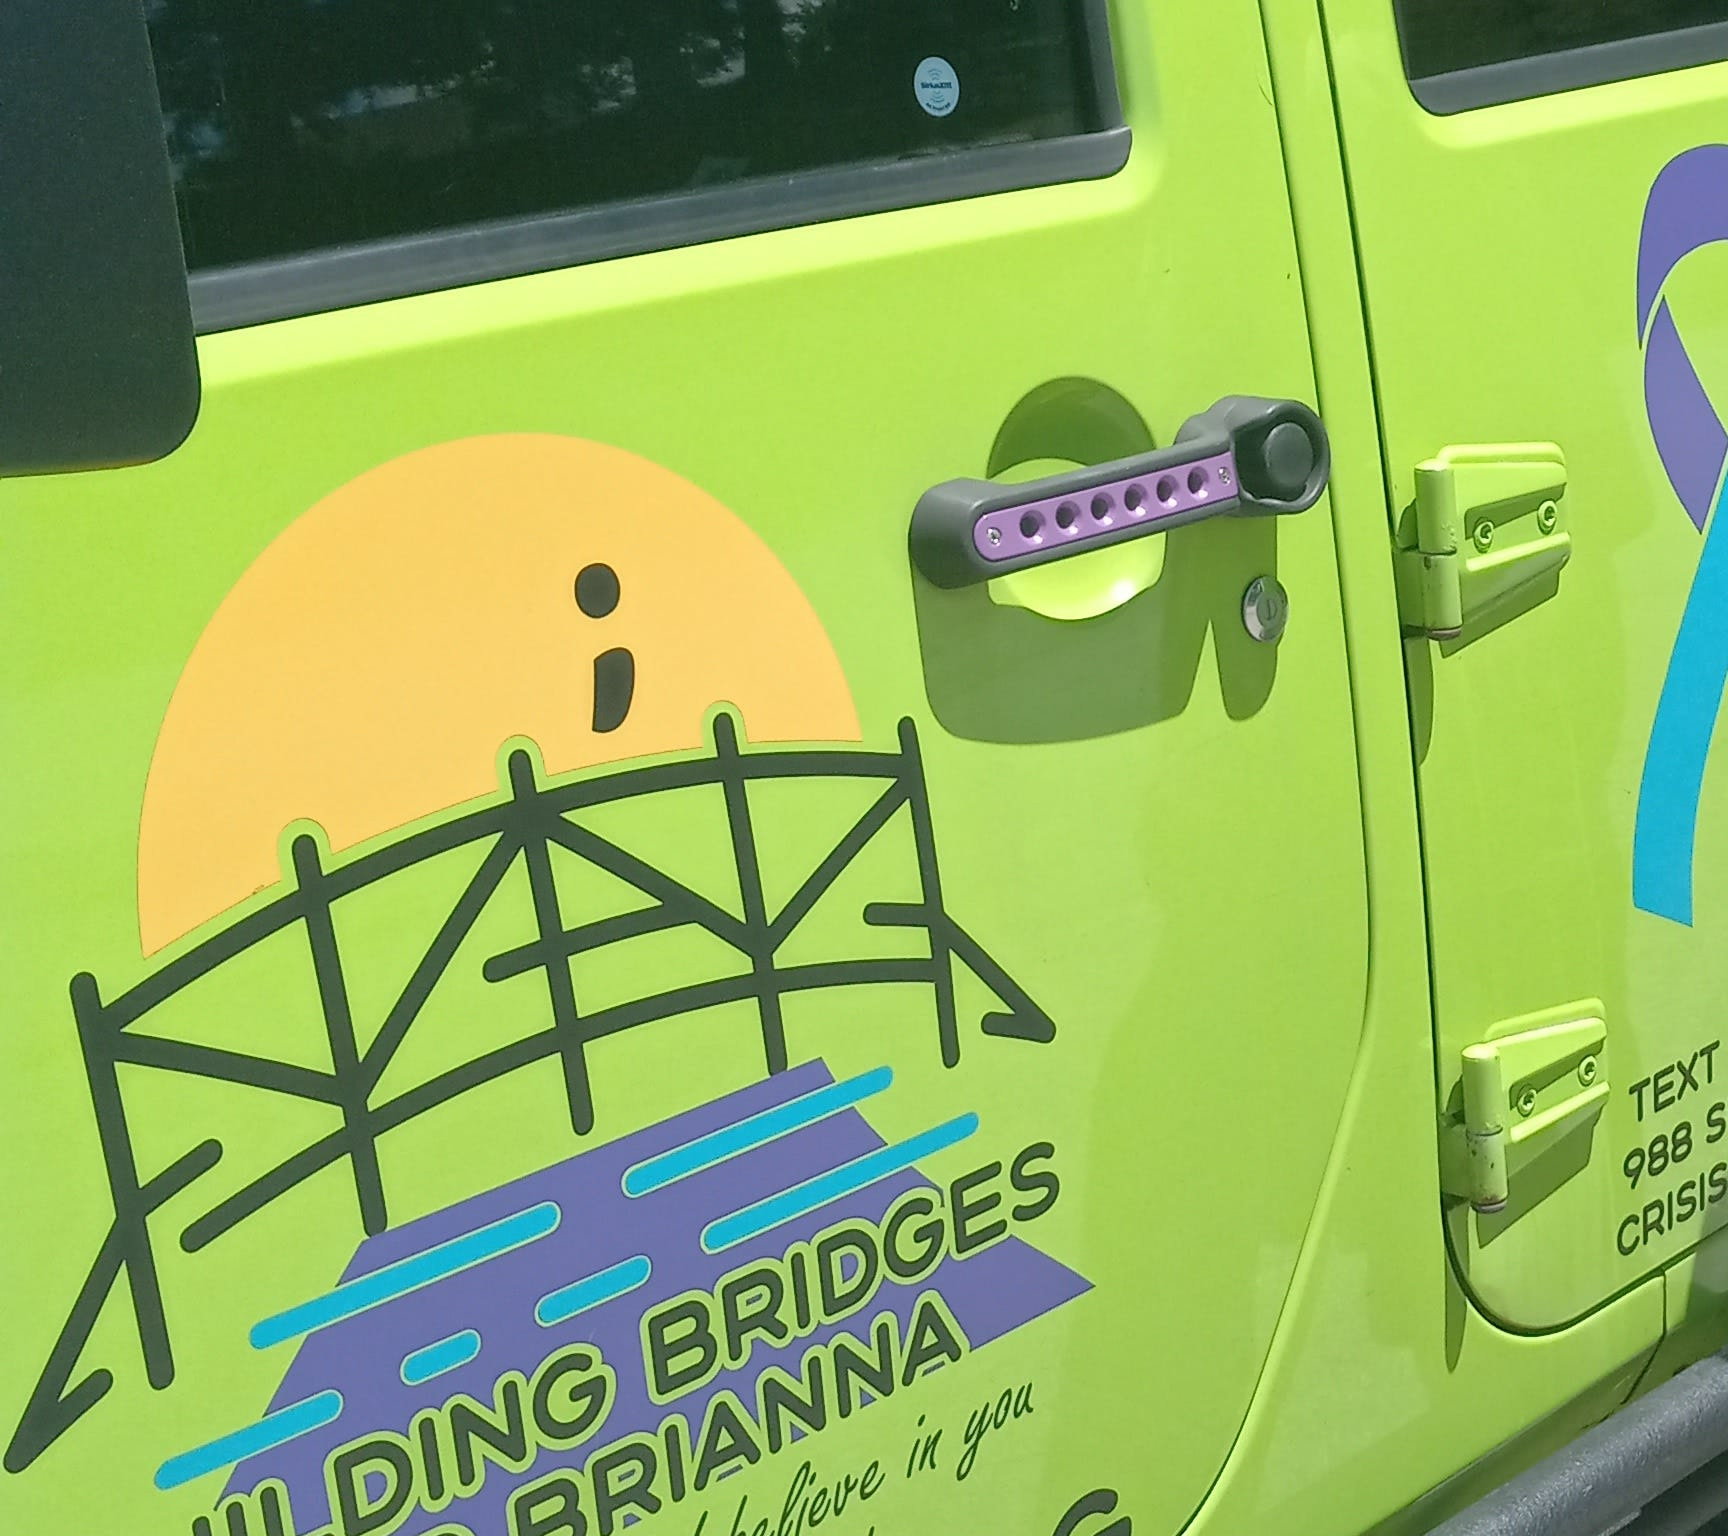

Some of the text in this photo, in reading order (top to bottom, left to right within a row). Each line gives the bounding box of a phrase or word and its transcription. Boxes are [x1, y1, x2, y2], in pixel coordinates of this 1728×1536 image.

[1629, 1041, 1719, 1122] TEXT
[1624, 1122, 1692, 1189] 988
[1618, 1163, 1728, 1256] CRISIS
[648, 1142, 1060, 1395] BRIDGES
[907, 1417, 943, 1478] in
[957, 1378, 1034, 1481] you
